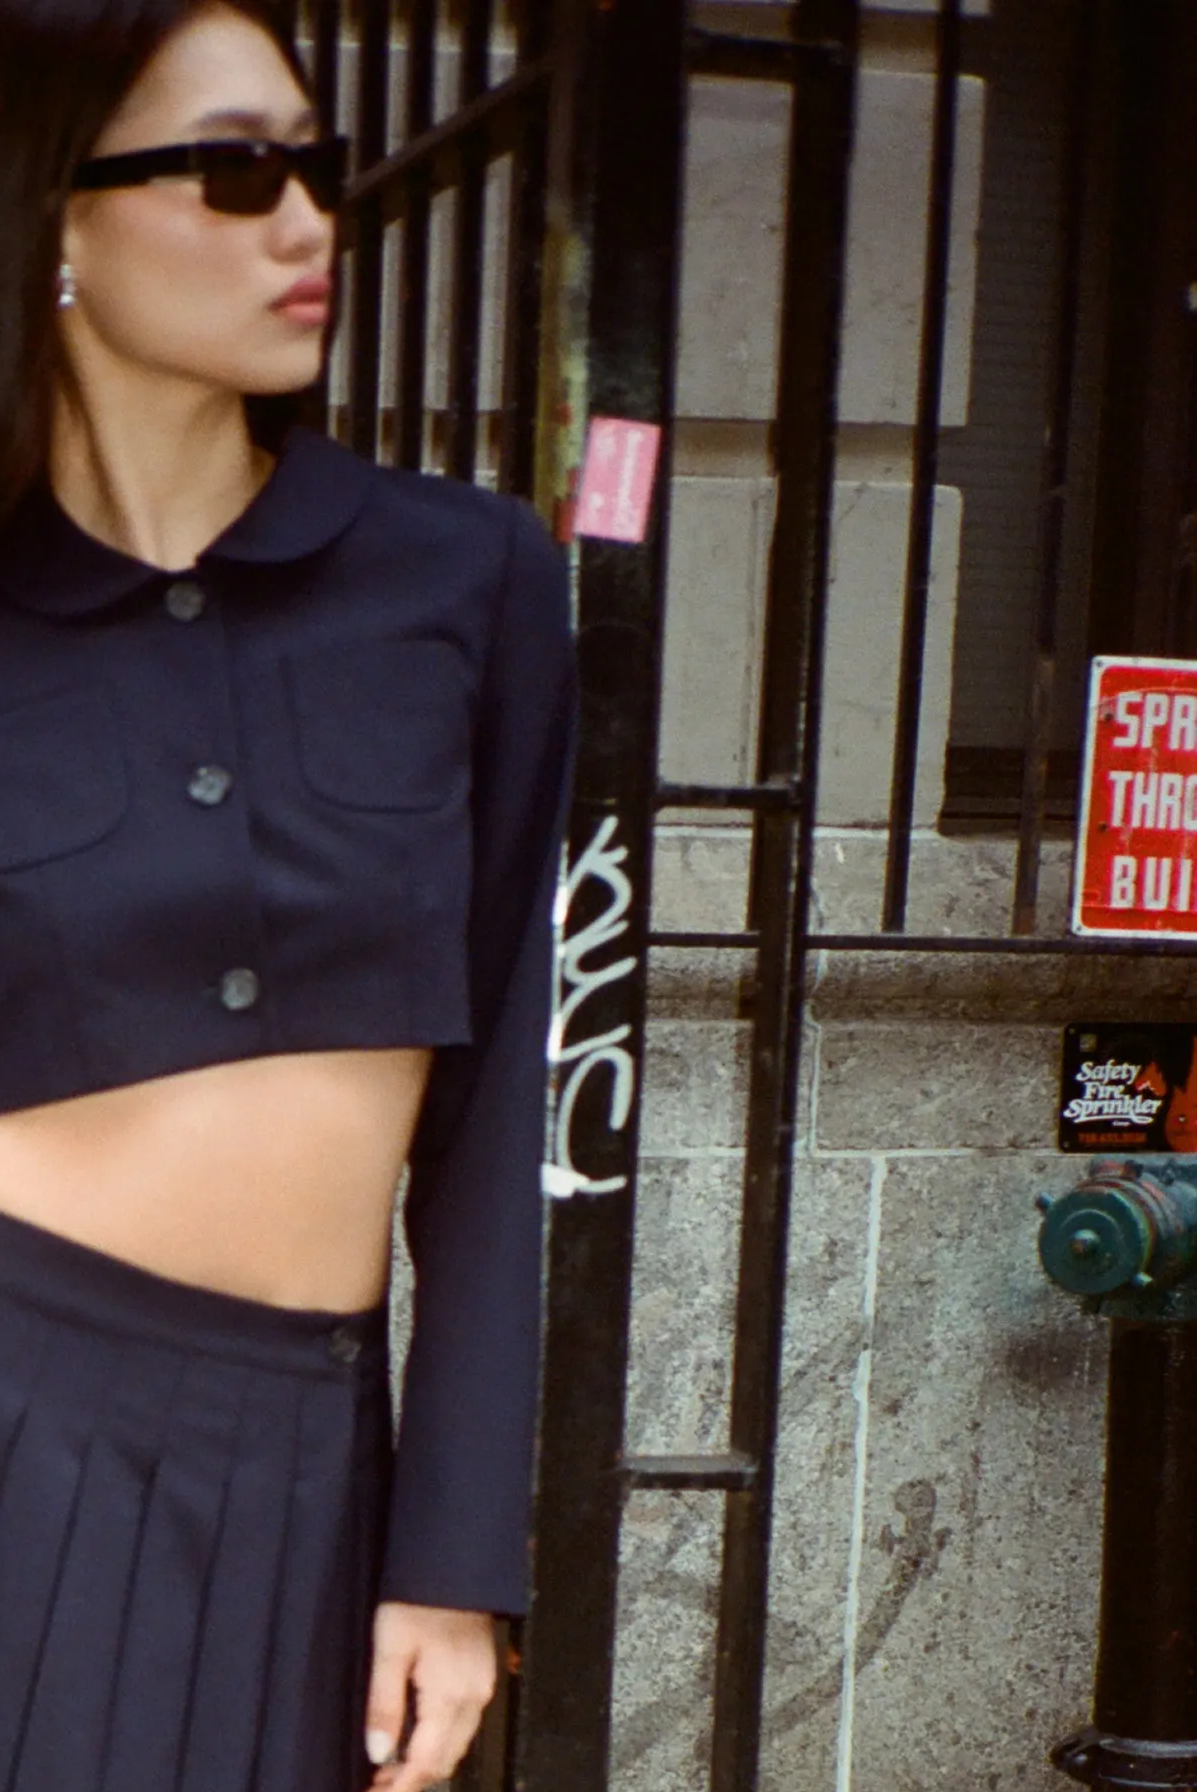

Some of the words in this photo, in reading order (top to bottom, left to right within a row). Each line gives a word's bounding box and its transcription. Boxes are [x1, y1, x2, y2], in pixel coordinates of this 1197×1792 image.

[1075, 1058, 1142, 1085] Safety
[1082, 1080, 1125, 1100] Fire
[1063, 1094, 1162, 1124] Sprinkler
